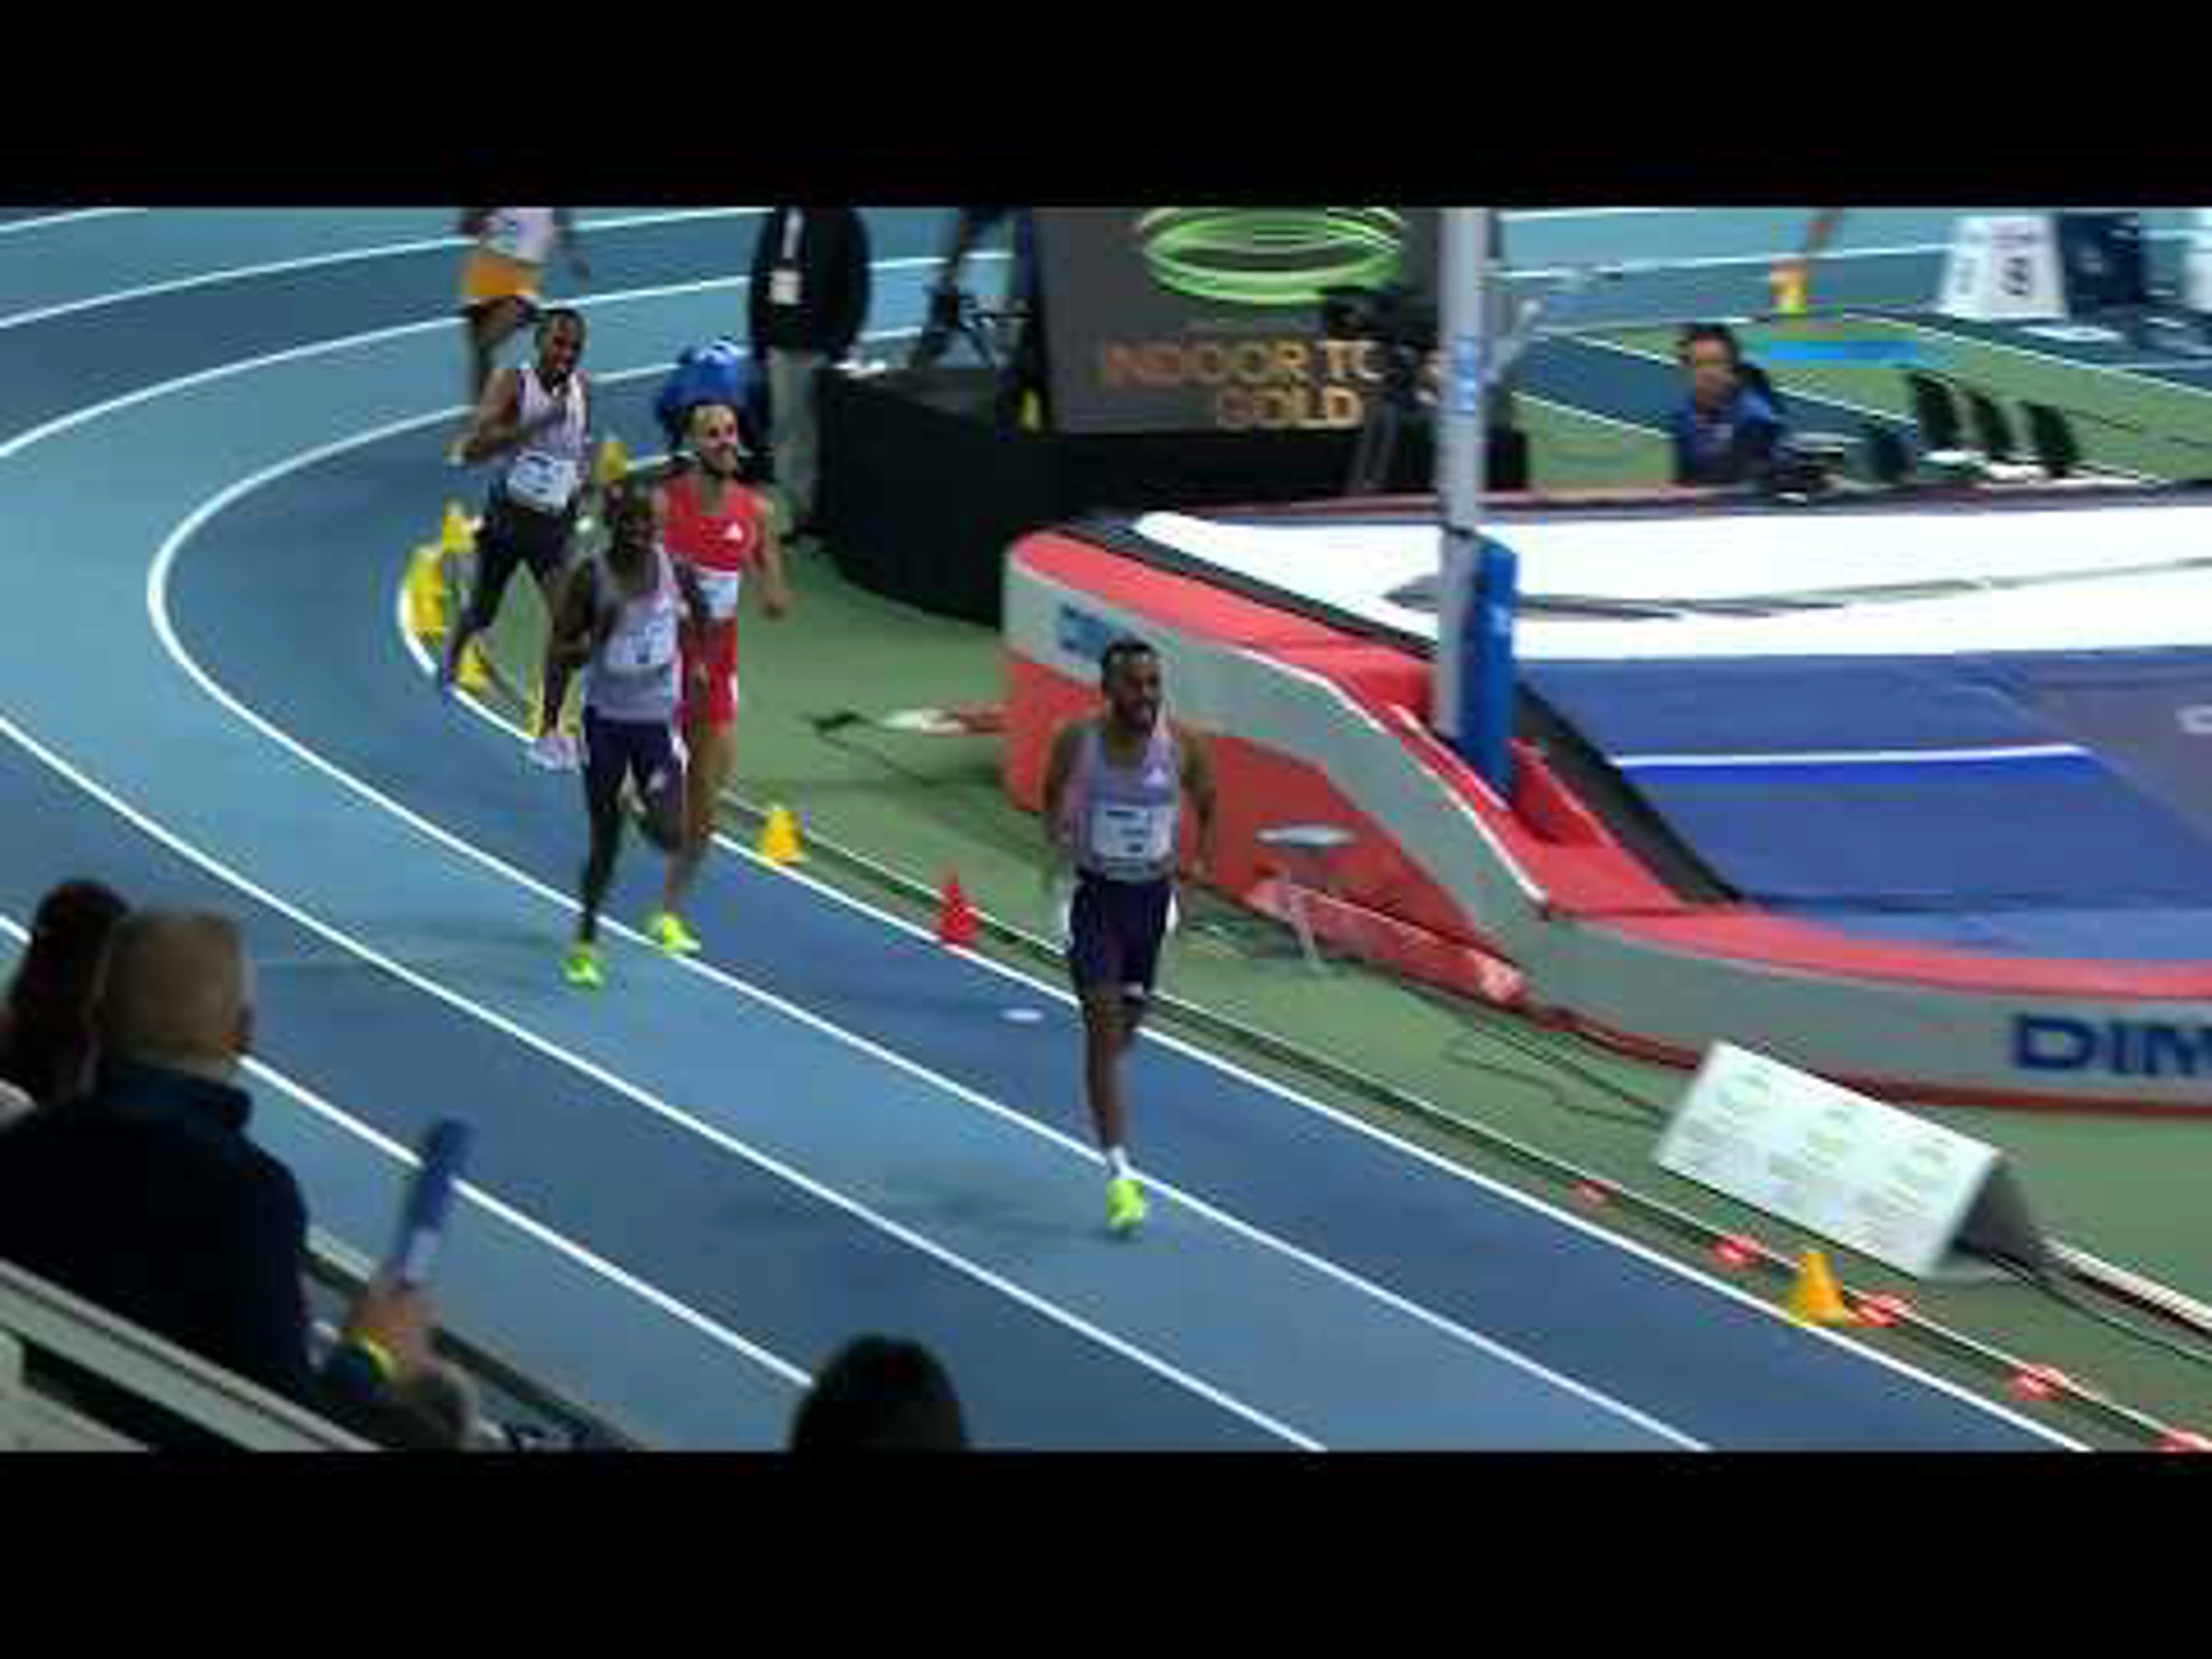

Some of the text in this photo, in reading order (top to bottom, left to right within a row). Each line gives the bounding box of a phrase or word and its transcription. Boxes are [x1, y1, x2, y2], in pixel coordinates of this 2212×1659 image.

[1104, 340, 1310, 385] INDOOR
[1216, 386, 1363, 430] GOLD
[2010, 1013, 2212, 1077] DIM
